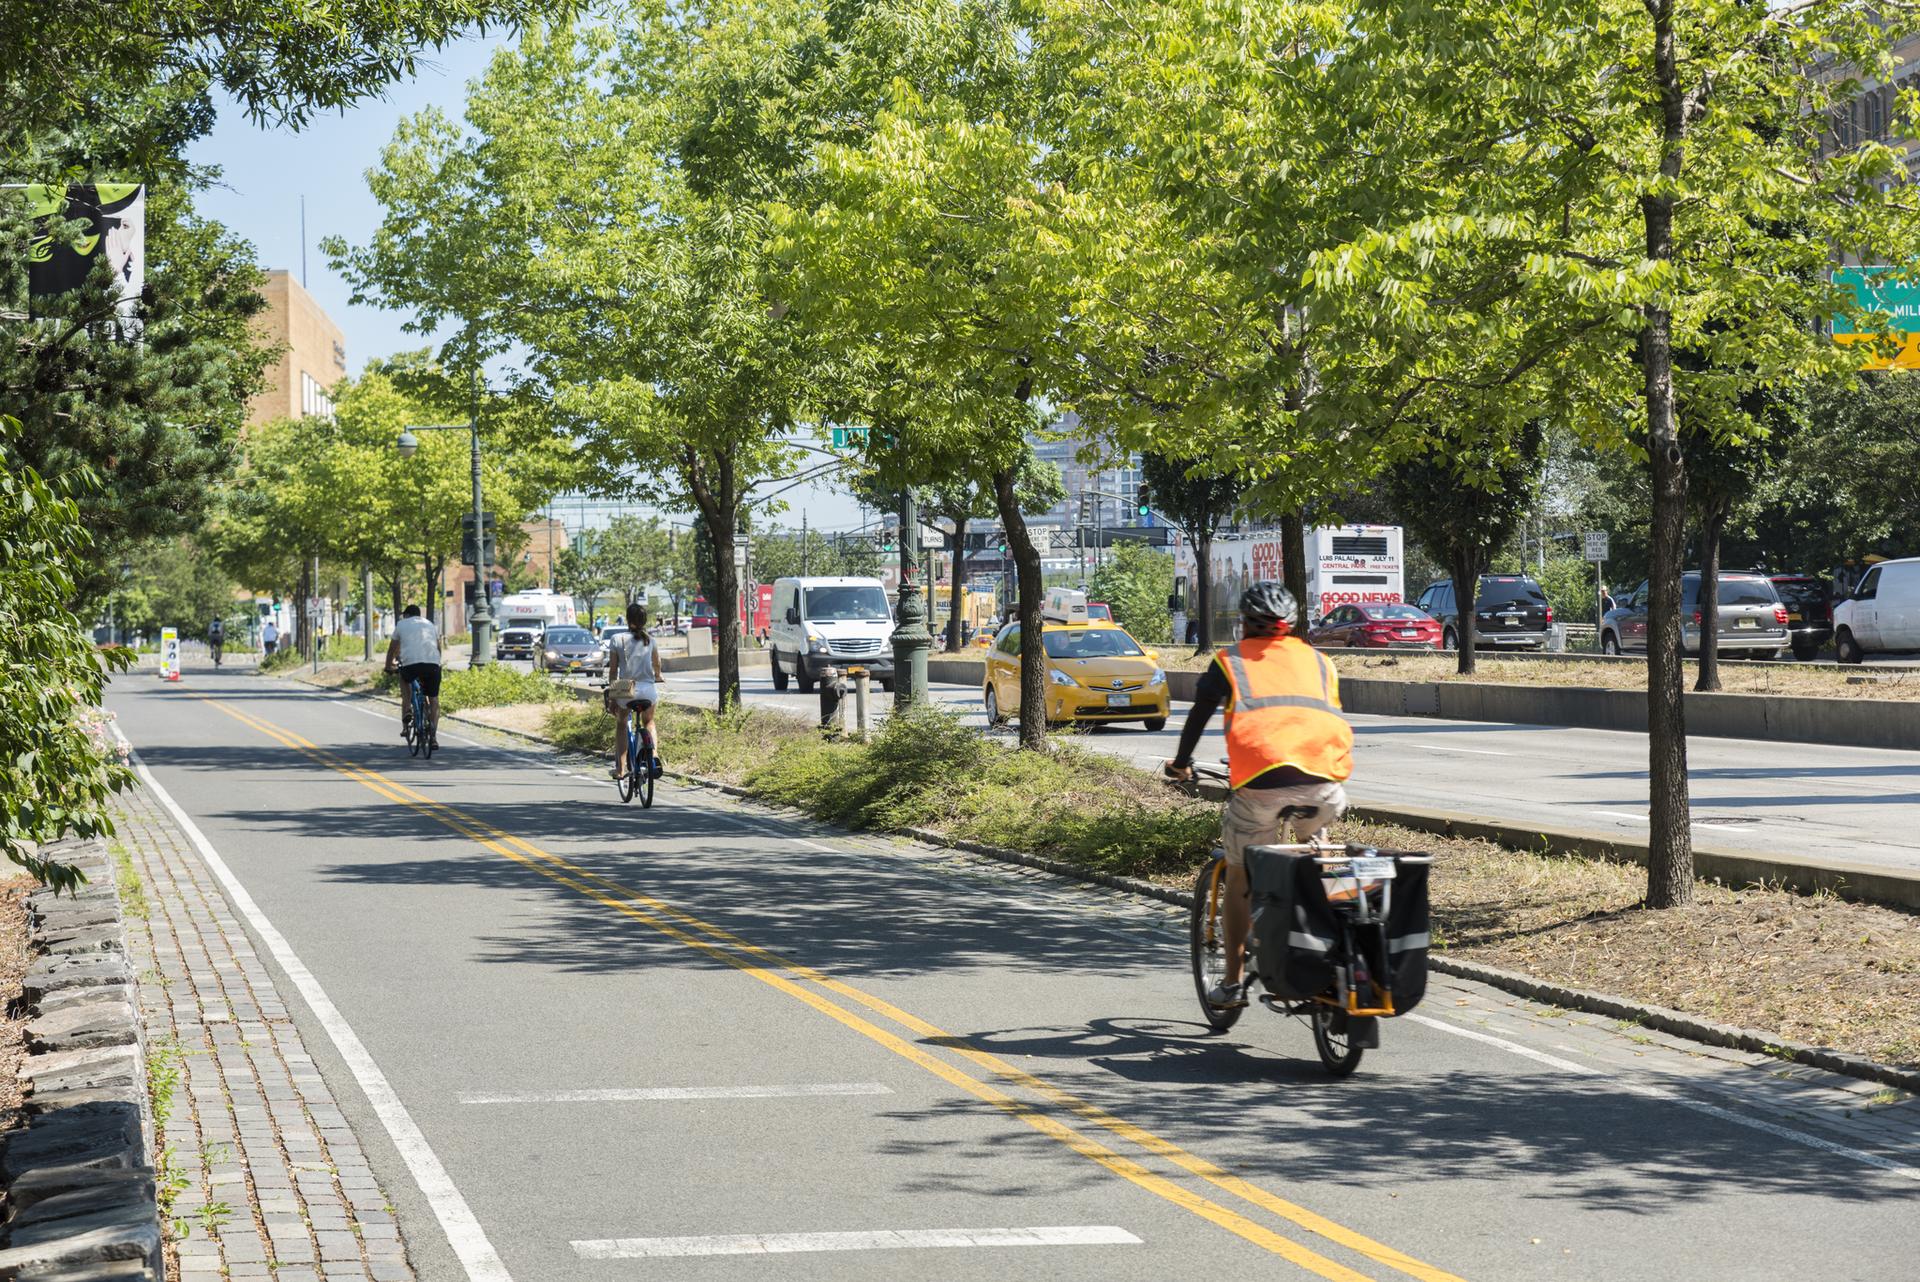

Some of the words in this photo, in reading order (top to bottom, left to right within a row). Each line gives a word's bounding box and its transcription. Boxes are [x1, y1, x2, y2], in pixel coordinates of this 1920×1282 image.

[1895, 304, 1920, 316] MIL
[1027, 528, 1047, 536] STOP
[1586, 533, 1607, 541] STOP
[1252, 543, 1275, 561] GOOD
[1261, 561, 1277, 579] THE
[1321, 592, 1360, 603] GOOD
[1362, 592, 1401, 603] NEWS
